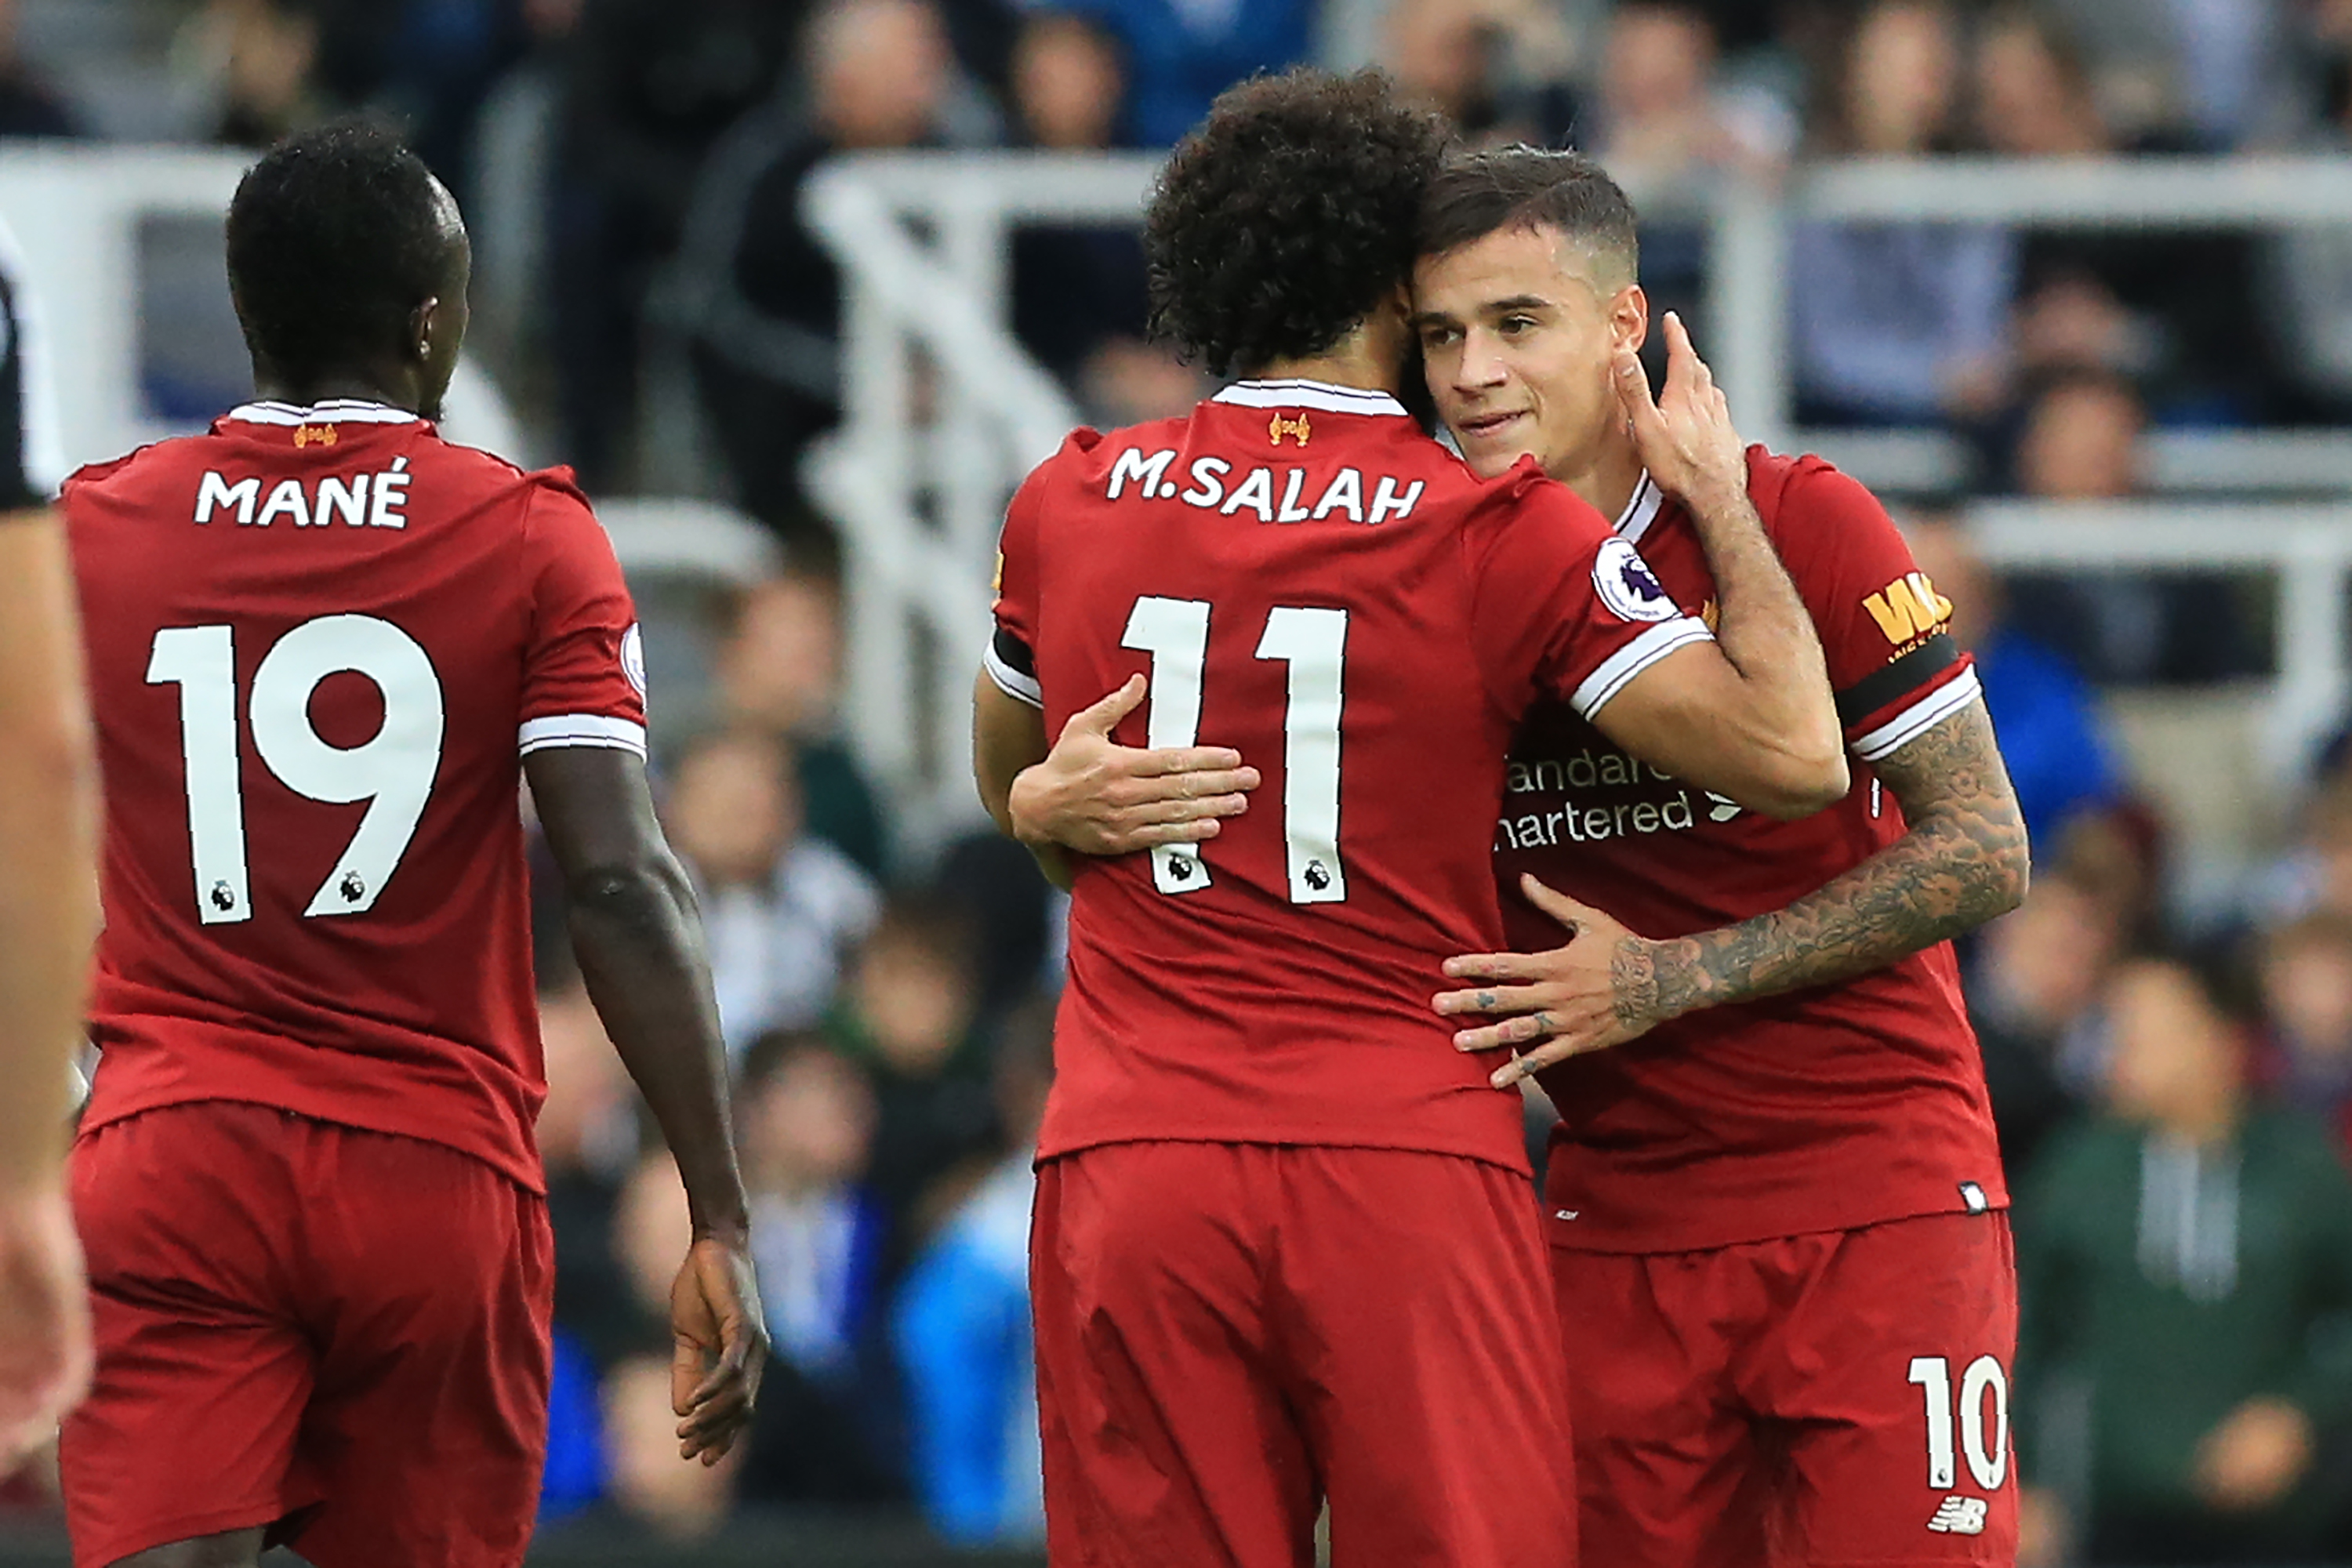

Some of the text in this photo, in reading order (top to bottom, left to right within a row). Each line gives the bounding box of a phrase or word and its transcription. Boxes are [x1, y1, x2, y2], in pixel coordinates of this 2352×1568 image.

[194, 455, 412, 529] MANÉ
[1106, 448, 1426, 524] M.SALAH
[145, 612, 447, 925] 19
[1120, 595, 1348, 904] 11
[1907, 1353, 2009, 1490] 10
